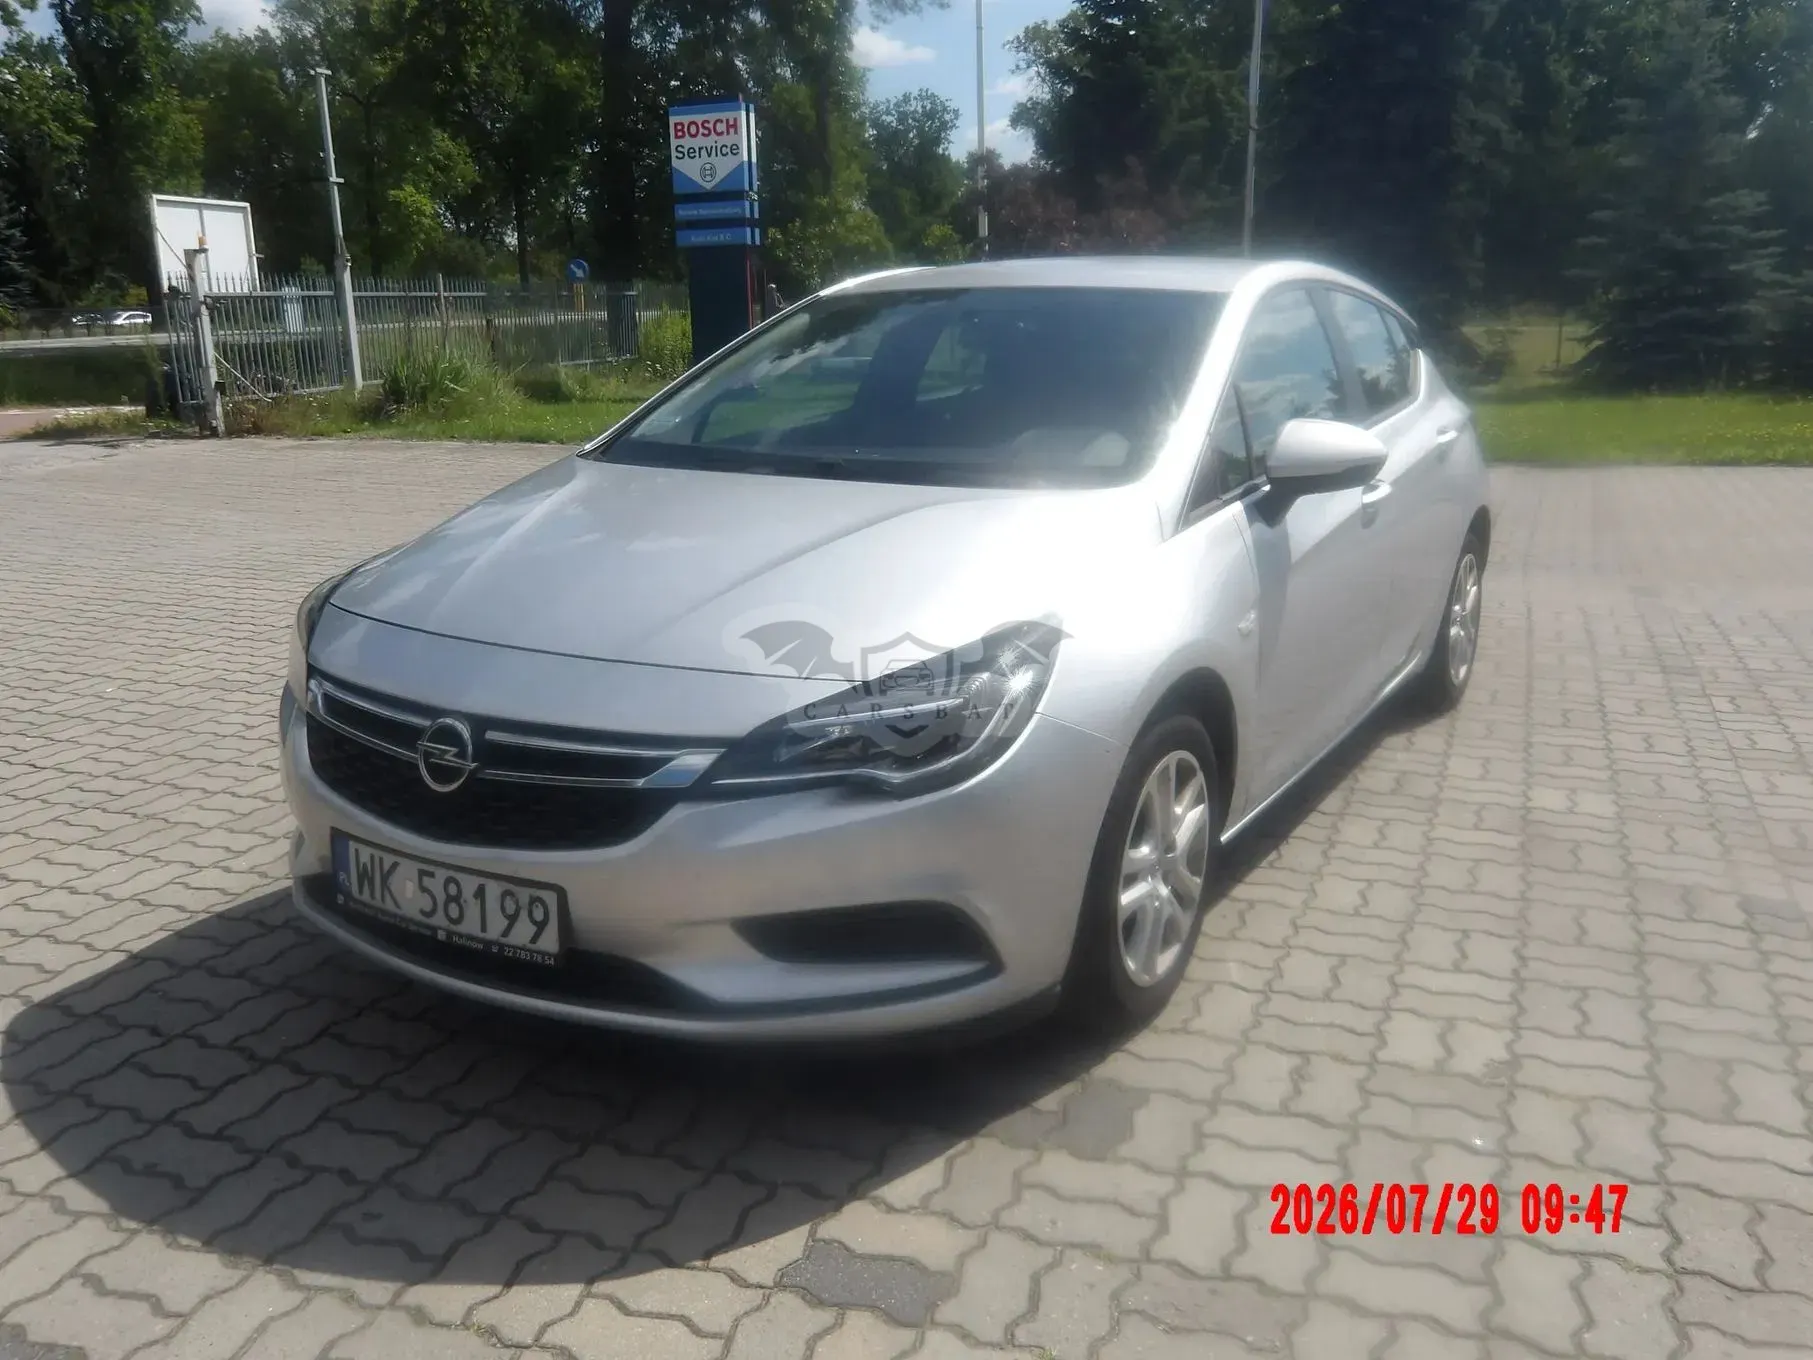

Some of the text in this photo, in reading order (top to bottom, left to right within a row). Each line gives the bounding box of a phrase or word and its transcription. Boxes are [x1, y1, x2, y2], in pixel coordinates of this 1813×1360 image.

[673, 117, 738, 140] BOSCH
[675, 141, 740, 160] Service
[338, 871, 351, 887] PL
[354, 847, 401, 909] WK
[417, 868, 549, 945] 58199
